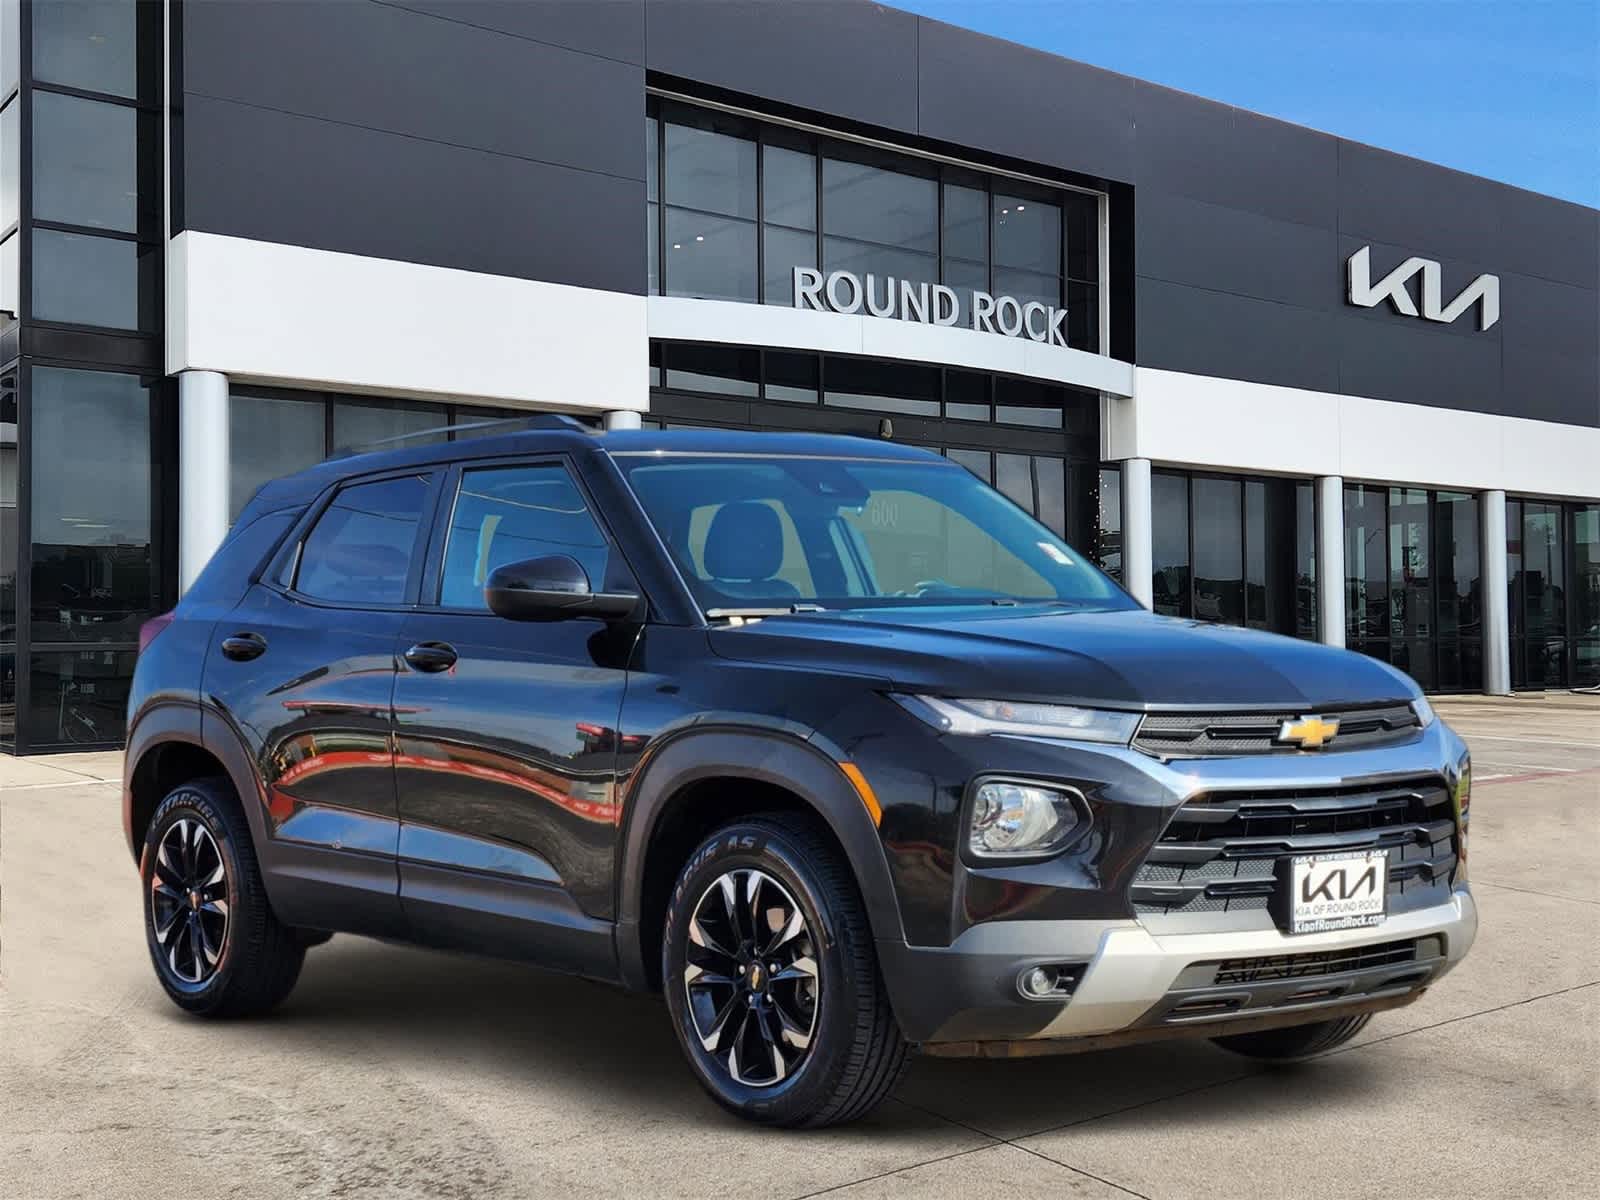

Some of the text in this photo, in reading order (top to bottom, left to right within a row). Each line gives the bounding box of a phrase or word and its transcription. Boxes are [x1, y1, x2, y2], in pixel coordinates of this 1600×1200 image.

[792, 266, 1069, 348] ROUND ROCK
[1347, 245, 1500, 331] KIA
[1296, 899, 1380, 917] KIA OF ROUND ROCK
[1302, 866, 1376, 903] KIA
